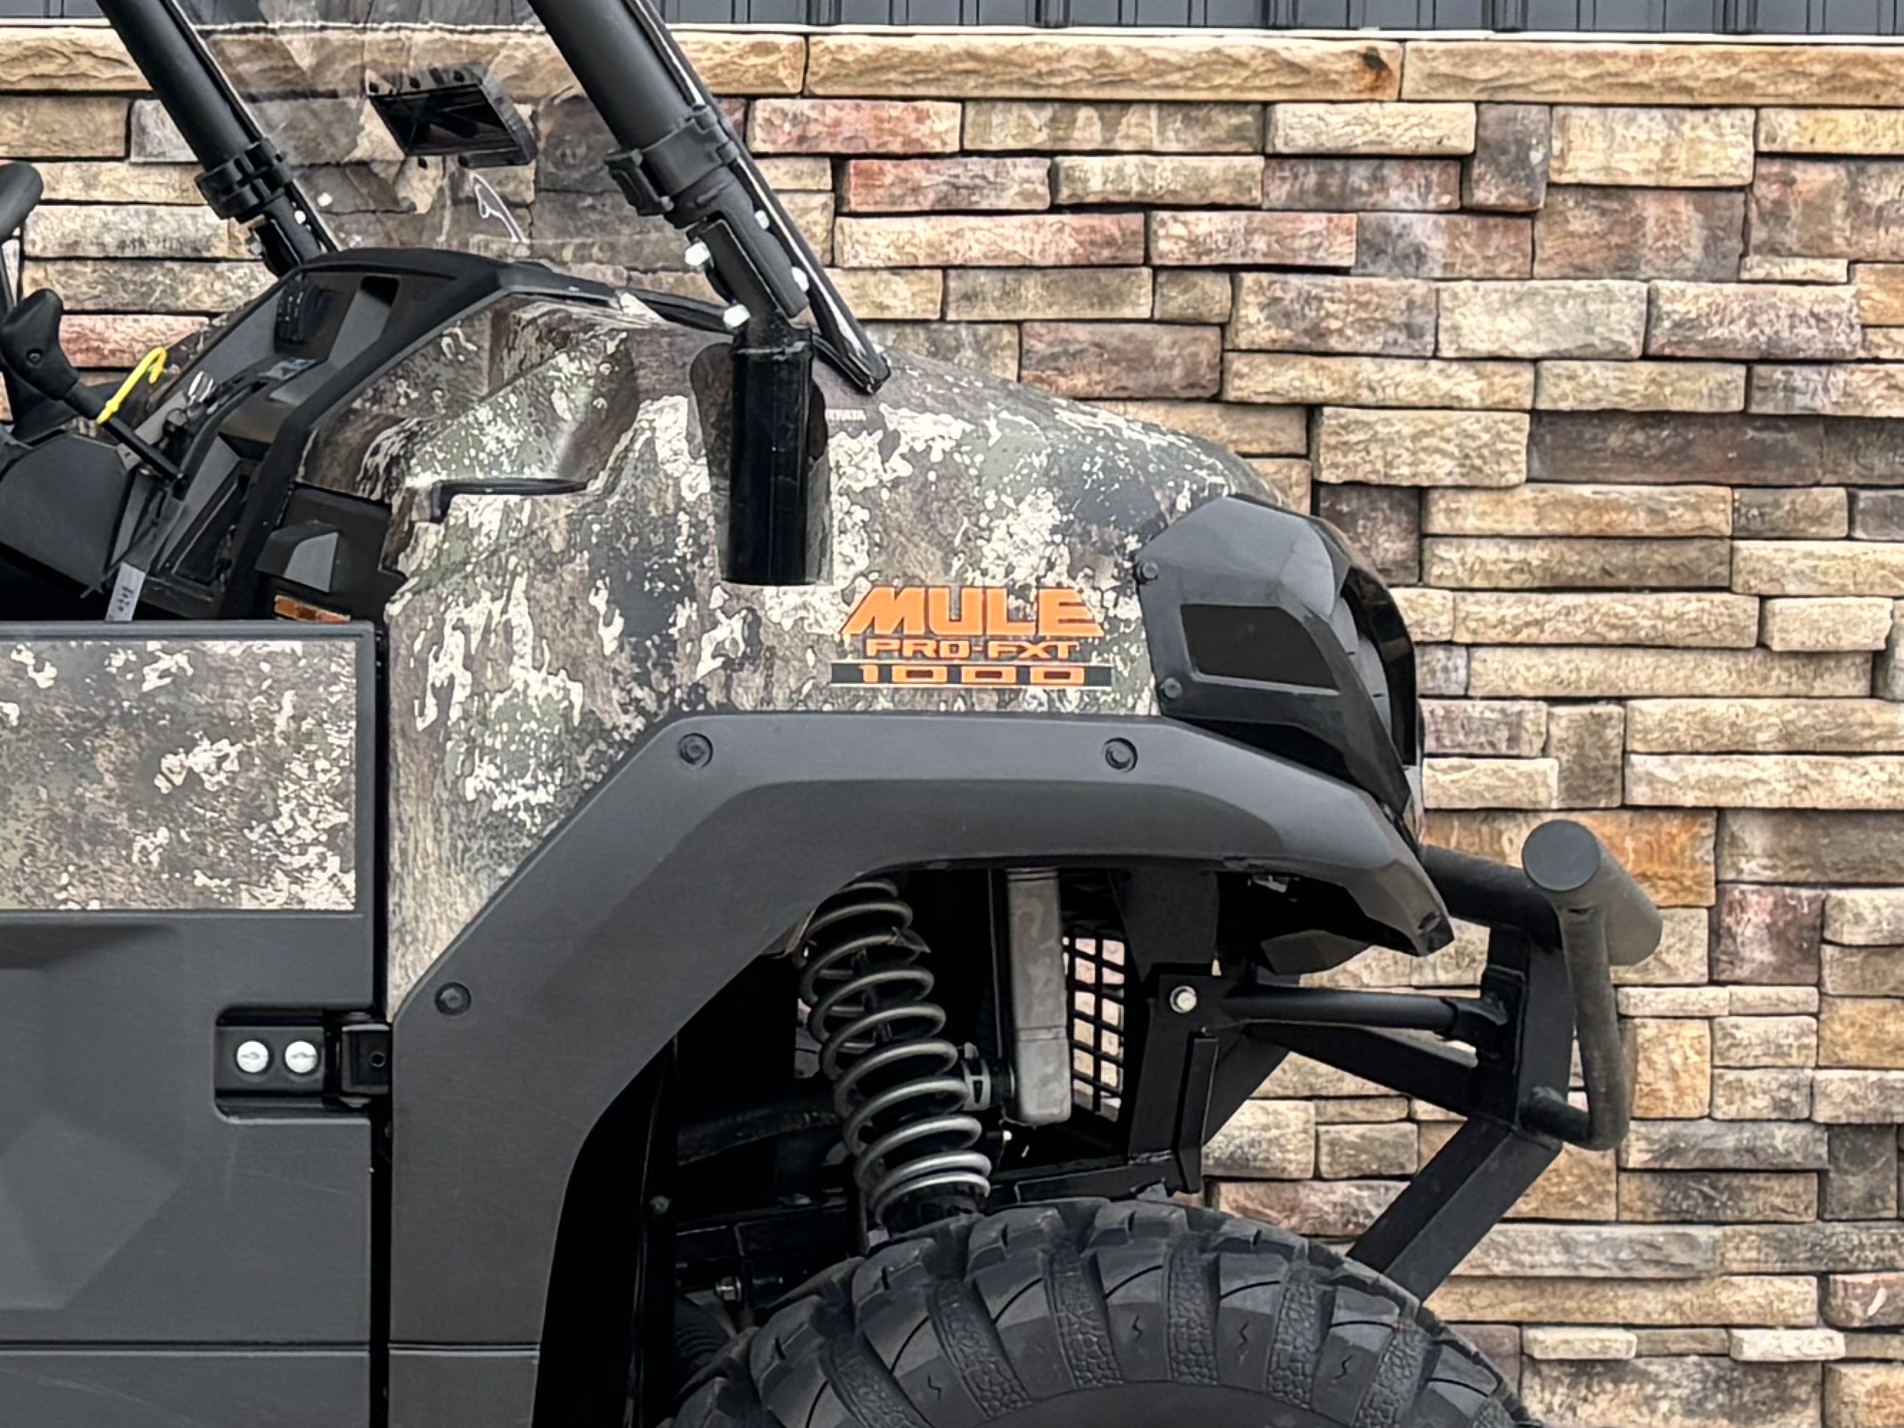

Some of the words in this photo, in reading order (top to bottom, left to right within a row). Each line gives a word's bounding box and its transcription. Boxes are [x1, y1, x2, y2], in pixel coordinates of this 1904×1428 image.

[840, 585, 1103, 638] MULE
[866, 638, 1079, 660] PRO-FXT
[860, 665, 1085, 685] 1000
